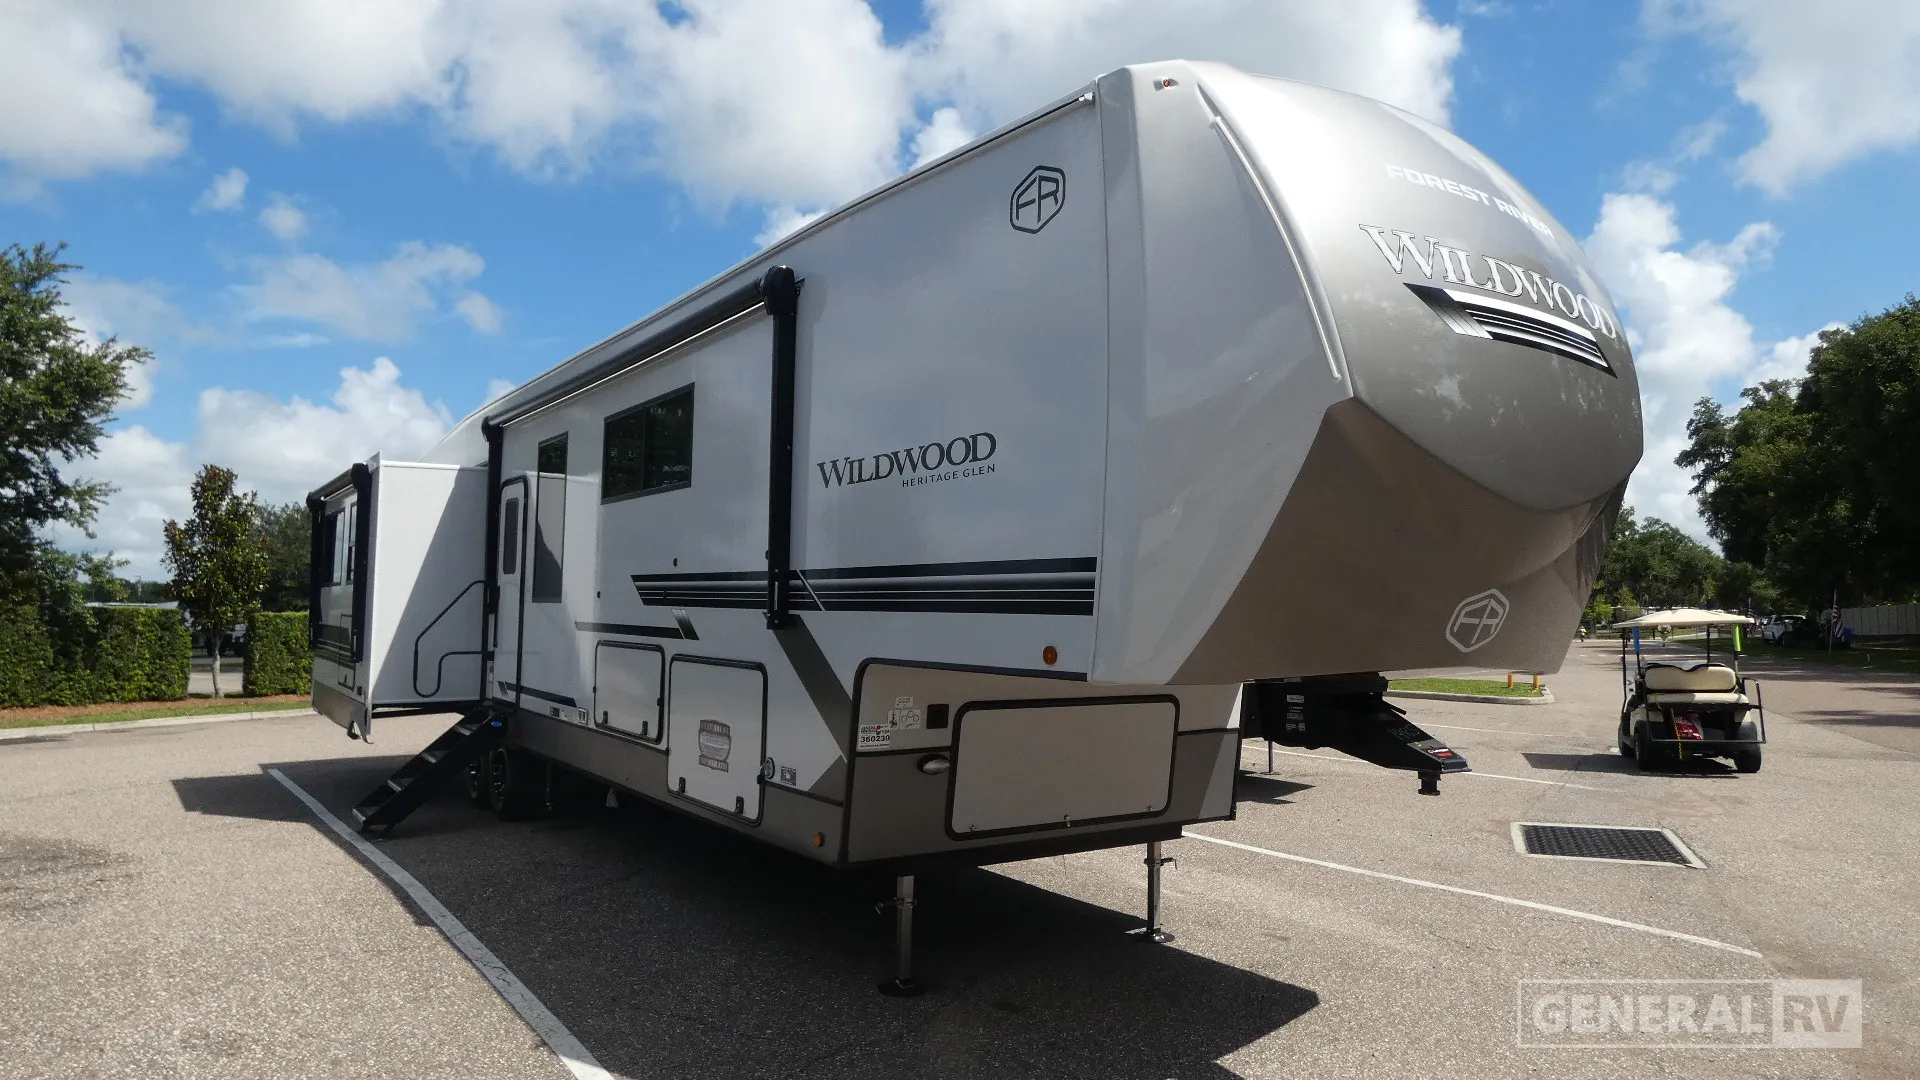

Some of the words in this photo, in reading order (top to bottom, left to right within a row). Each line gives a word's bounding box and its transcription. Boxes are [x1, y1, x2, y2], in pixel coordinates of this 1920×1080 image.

[1385, 164, 1490, 206] FOREST
[1492, 196, 1556, 240] RIVER
[1359, 223, 1617, 340] WILDWOOD
[816, 431, 997, 489] WILDWOOD
[902, 471, 959, 488] HERITAGE
[962, 463, 996, 478] GLEN
[860, 735, 891, 743] 360230
